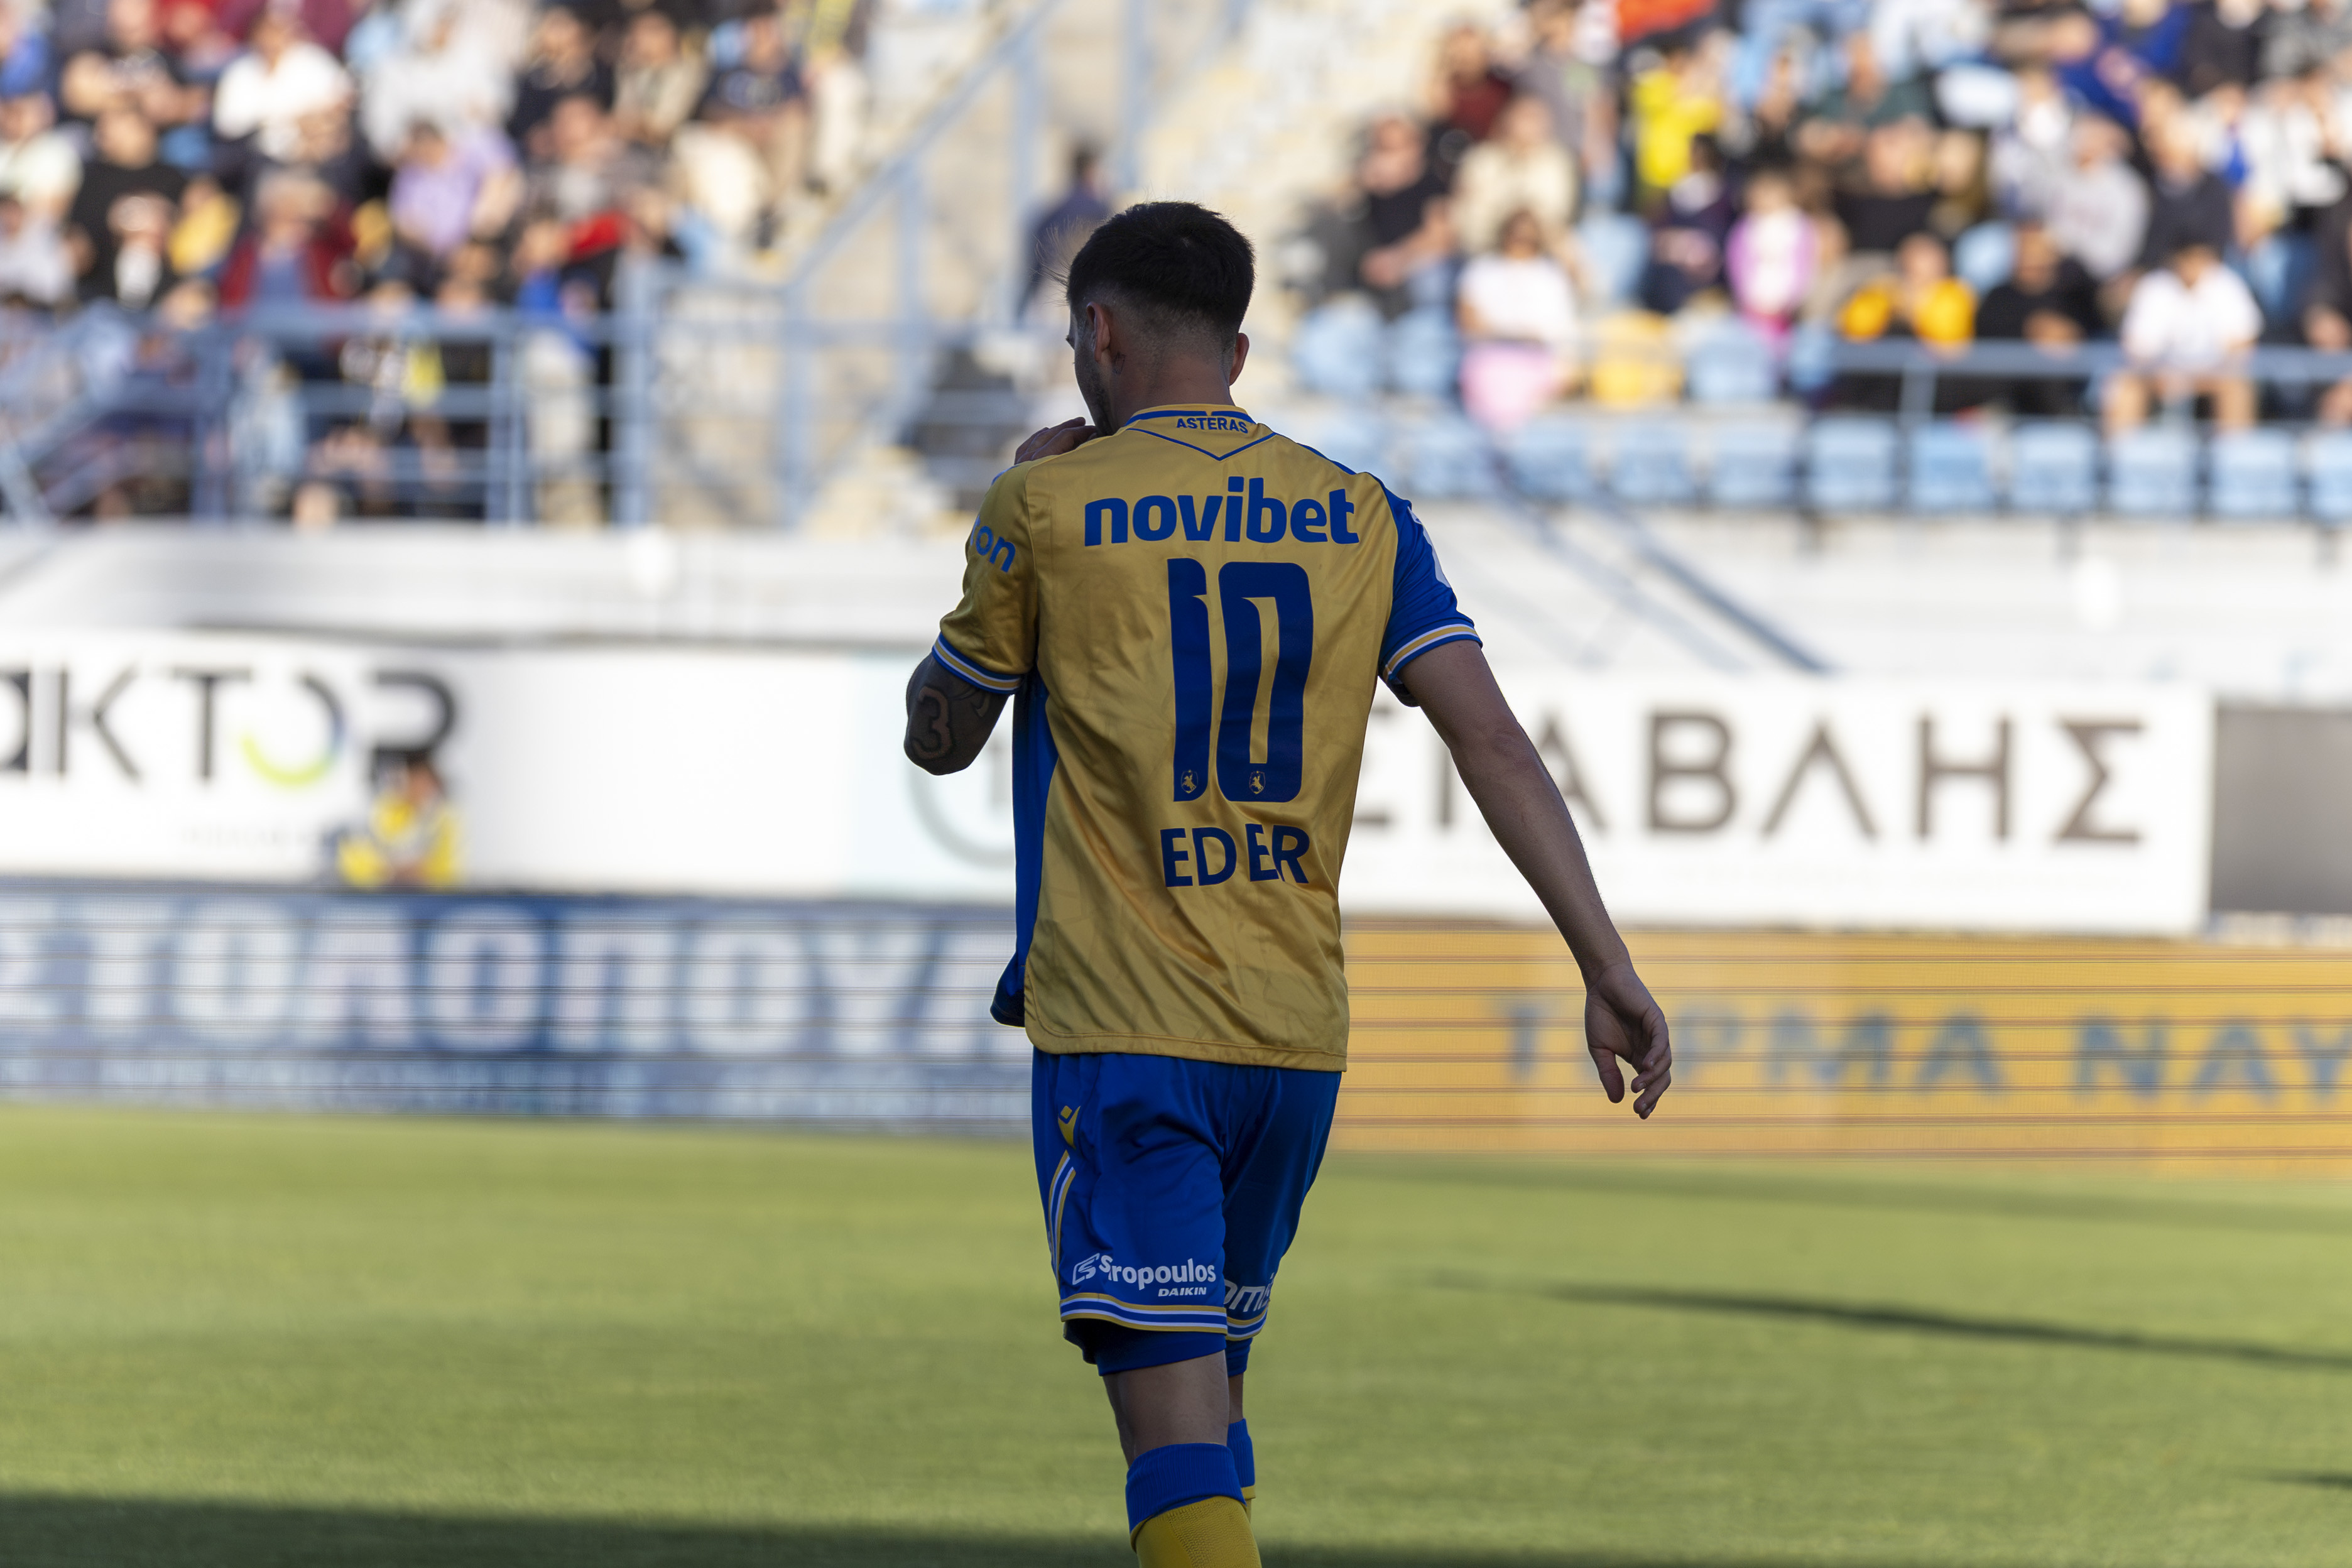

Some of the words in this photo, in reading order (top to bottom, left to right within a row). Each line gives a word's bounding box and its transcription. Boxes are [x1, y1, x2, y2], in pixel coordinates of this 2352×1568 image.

[1177, 417, 1248, 433] ASTERAS
[1084, 476, 1359, 547] novibet
[1167, 558, 1314, 803] 10
[1160, 823, 1310, 888] EDER
[1494, 994, 2008, 1099] ΤΡΜΑ
[1158, 1287, 1207, 1297] DAIKIN
